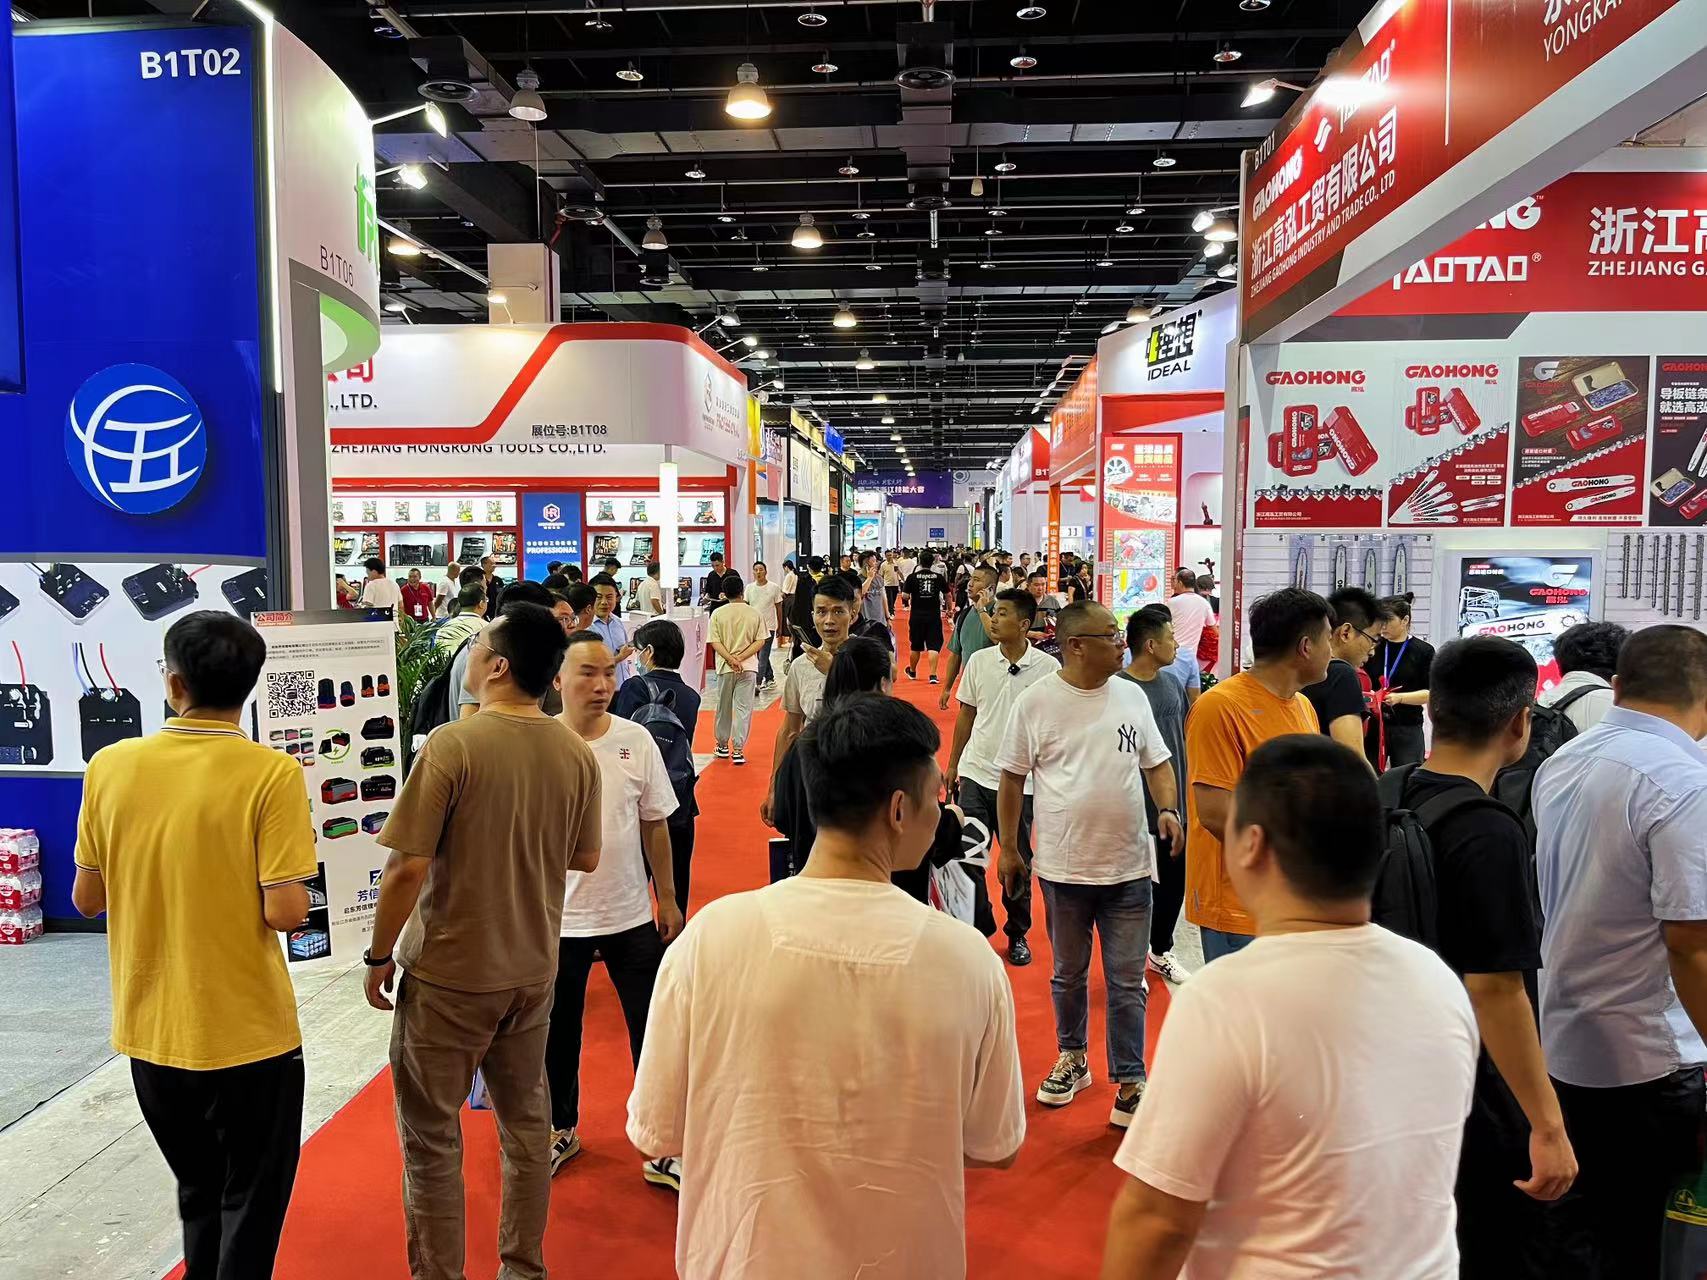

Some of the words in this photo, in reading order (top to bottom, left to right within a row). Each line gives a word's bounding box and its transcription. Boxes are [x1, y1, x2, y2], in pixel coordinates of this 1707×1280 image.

[1543, 0, 1625, 62] YONGKA
[140, 47, 241, 79] B1T02
[1254, 131, 1275, 171] B1T01
[1251, 104, 1397, 281] 浙江高泓工贸有限公司
[1252, 145, 1303, 221] GAOHONG
[1250, 270, 1272, 298] ZHEJIANG
[1271, 250, 1297, 281] GAOHONG
[1297, 225, 1326, 261] INDUSTRY
[1326, 214, 1341, 239] AND
[1341, 194, 1364, 226] TRADE
[1380, 169, 1395, 195] LTD
[319, 244, 354, 287] B1T06
[1587, 261, 1687, 276] ZHEJIANG
[1147, 359, 1191, 382] IDEAL
[1265, 370, 1366, 386] GAOHONG
[1404, 364, 1499, 379] GAOHONG
[531, 423, 608, 437] 展位号:B1T08
[331, 444, 401, 454] ZHEJIANG
[500, 444, 544, 454] TOOLS
